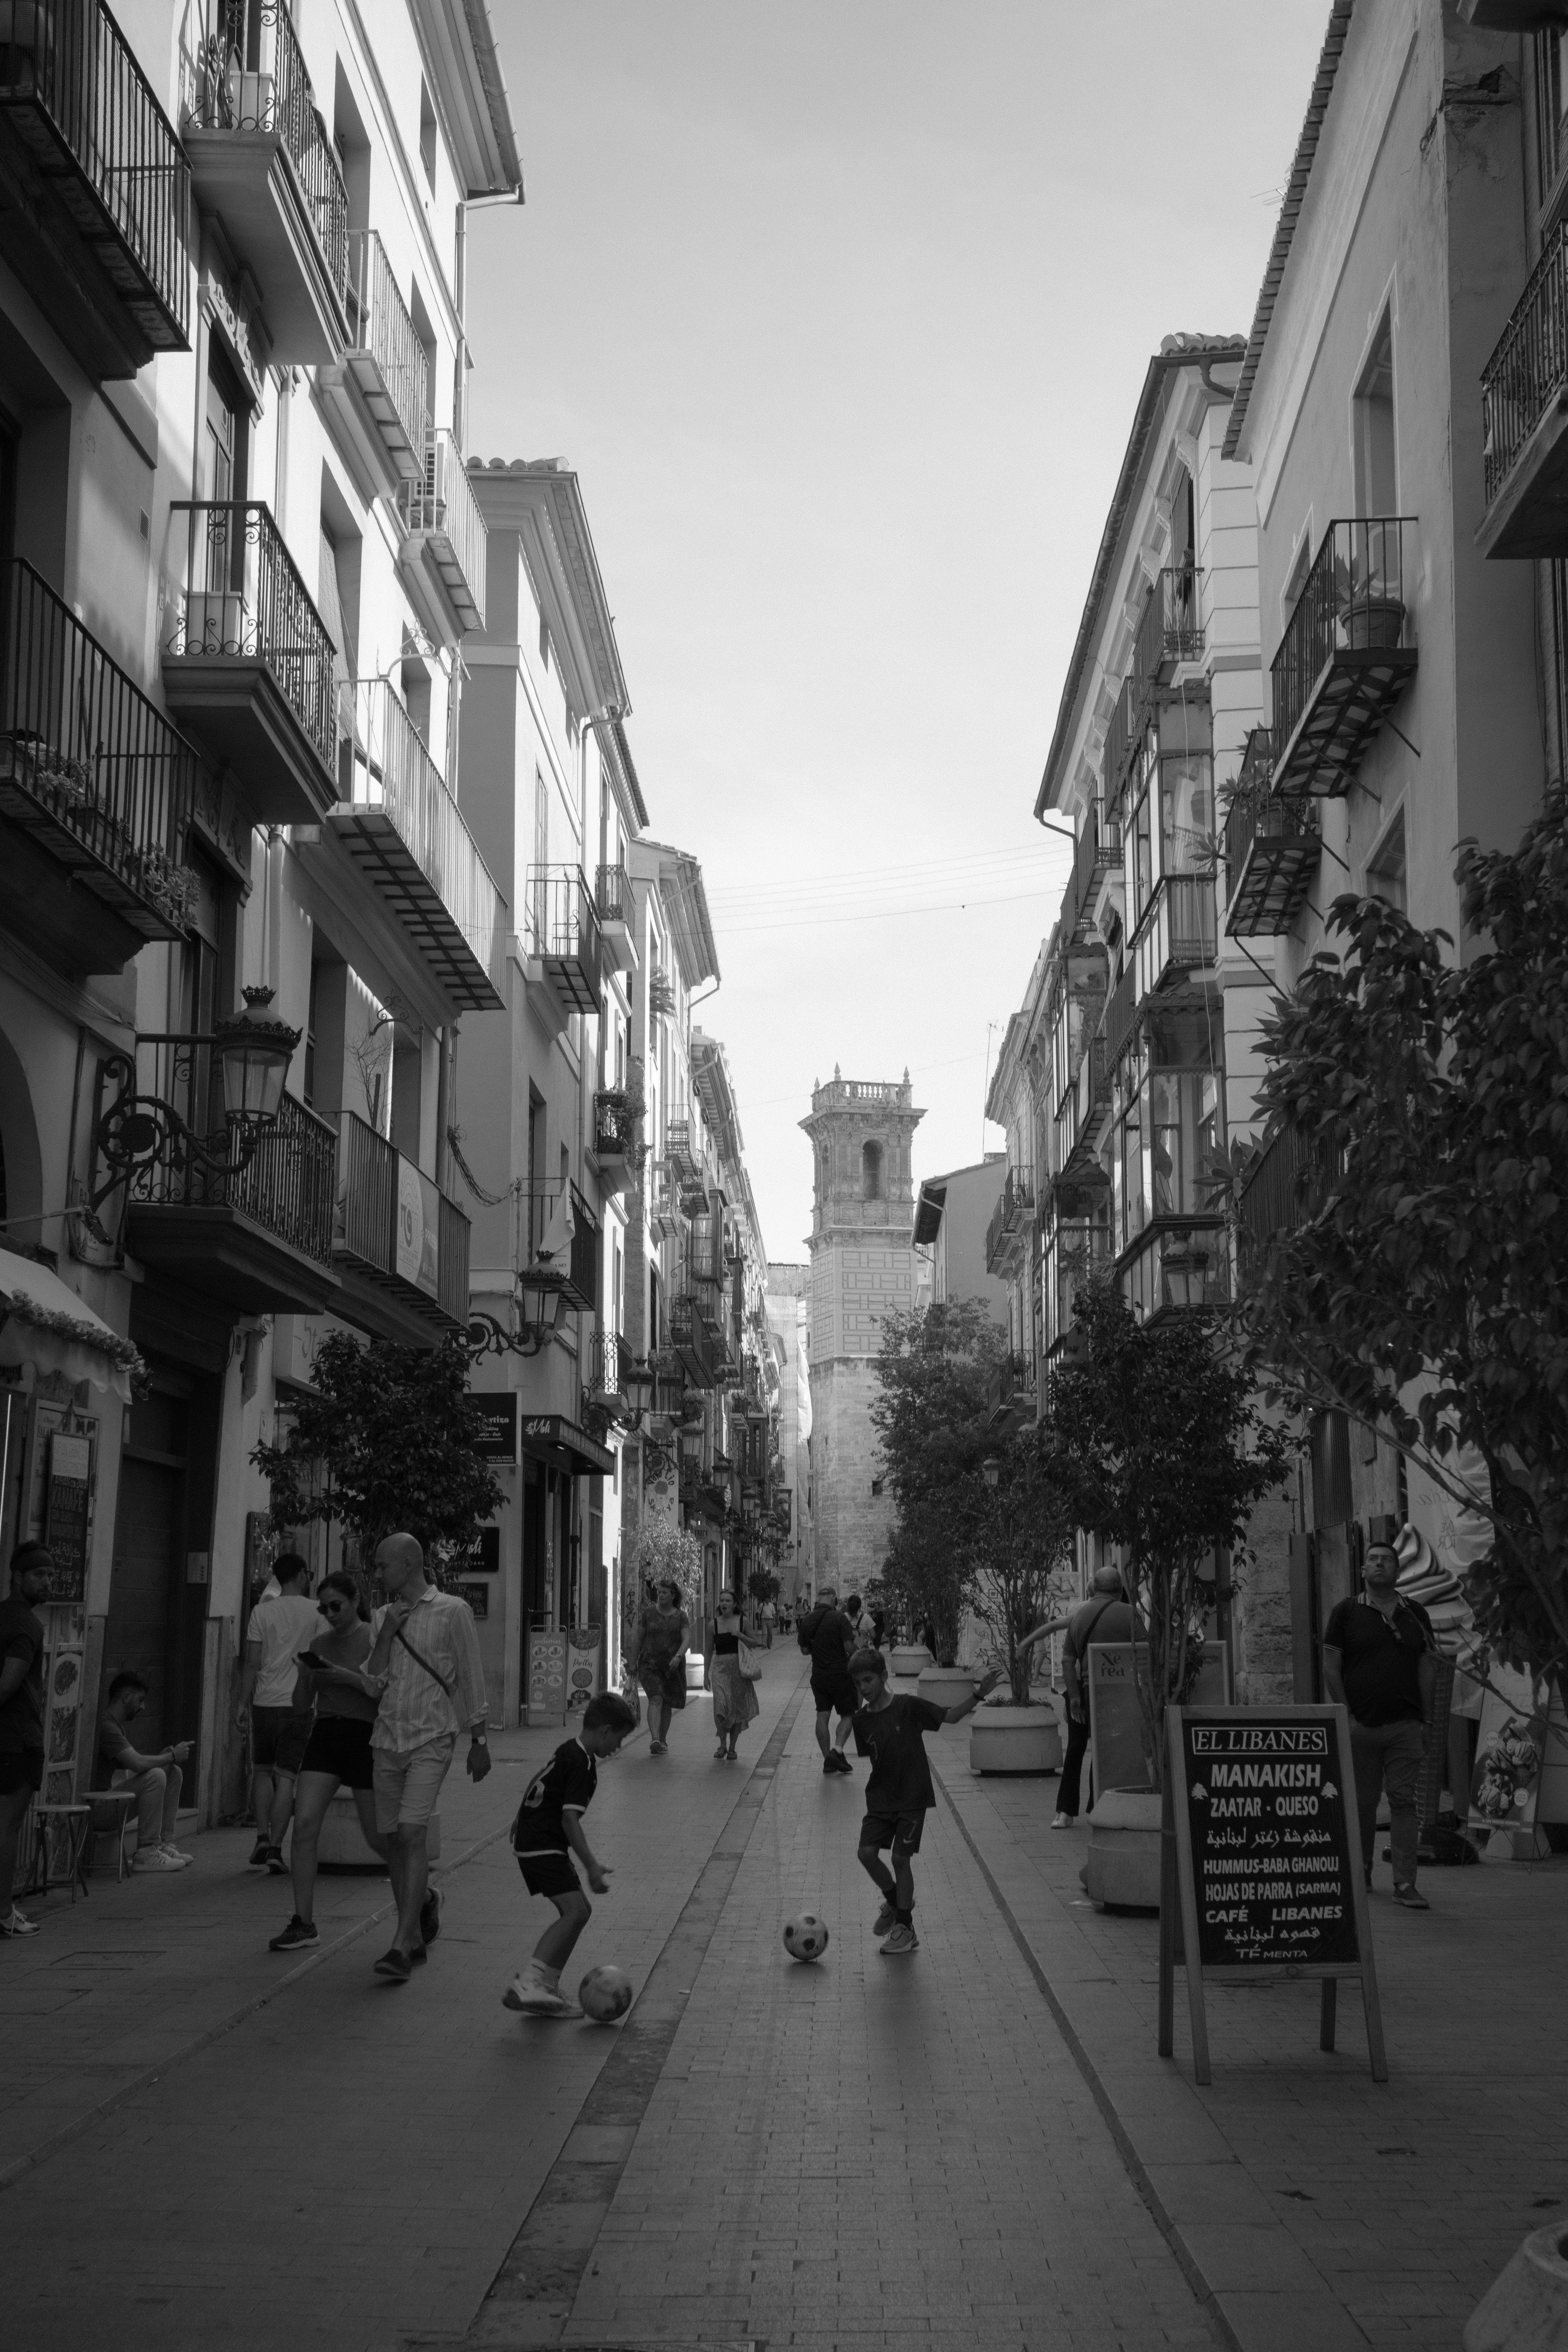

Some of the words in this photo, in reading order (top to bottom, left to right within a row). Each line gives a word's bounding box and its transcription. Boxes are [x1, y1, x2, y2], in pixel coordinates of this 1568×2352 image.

[573, 1659, 592, 1668] Paellas
[1196, 1731, 1222, 1750] EL
[1227, 1731, 1323, 1751] LIBANES
[1211, 1764, 1321, 1787] MANAKISH
[1211, 1797, 1261, 1817] ZAATAR
[1276, 1795, 1319, 1816] QUESO
[1292, 1856, 1339, 1873] GHANOUJ
[1206, 1883, 1239, 1901] HOJAS
[1241, 1882, 1255, 1900] DE
[1258, 1882, 1293, 1900] PARRA
[1296, 1882, 1341, 1898] (SARMA)
[1206, 1905, 1249, 1923] CAFÉ
[1272, 1905, 1342, 1921] LIBANES
[1236, 1943, 1261, 1958] TÉ
[1263, 1950, 1307, 1958] MENTA
